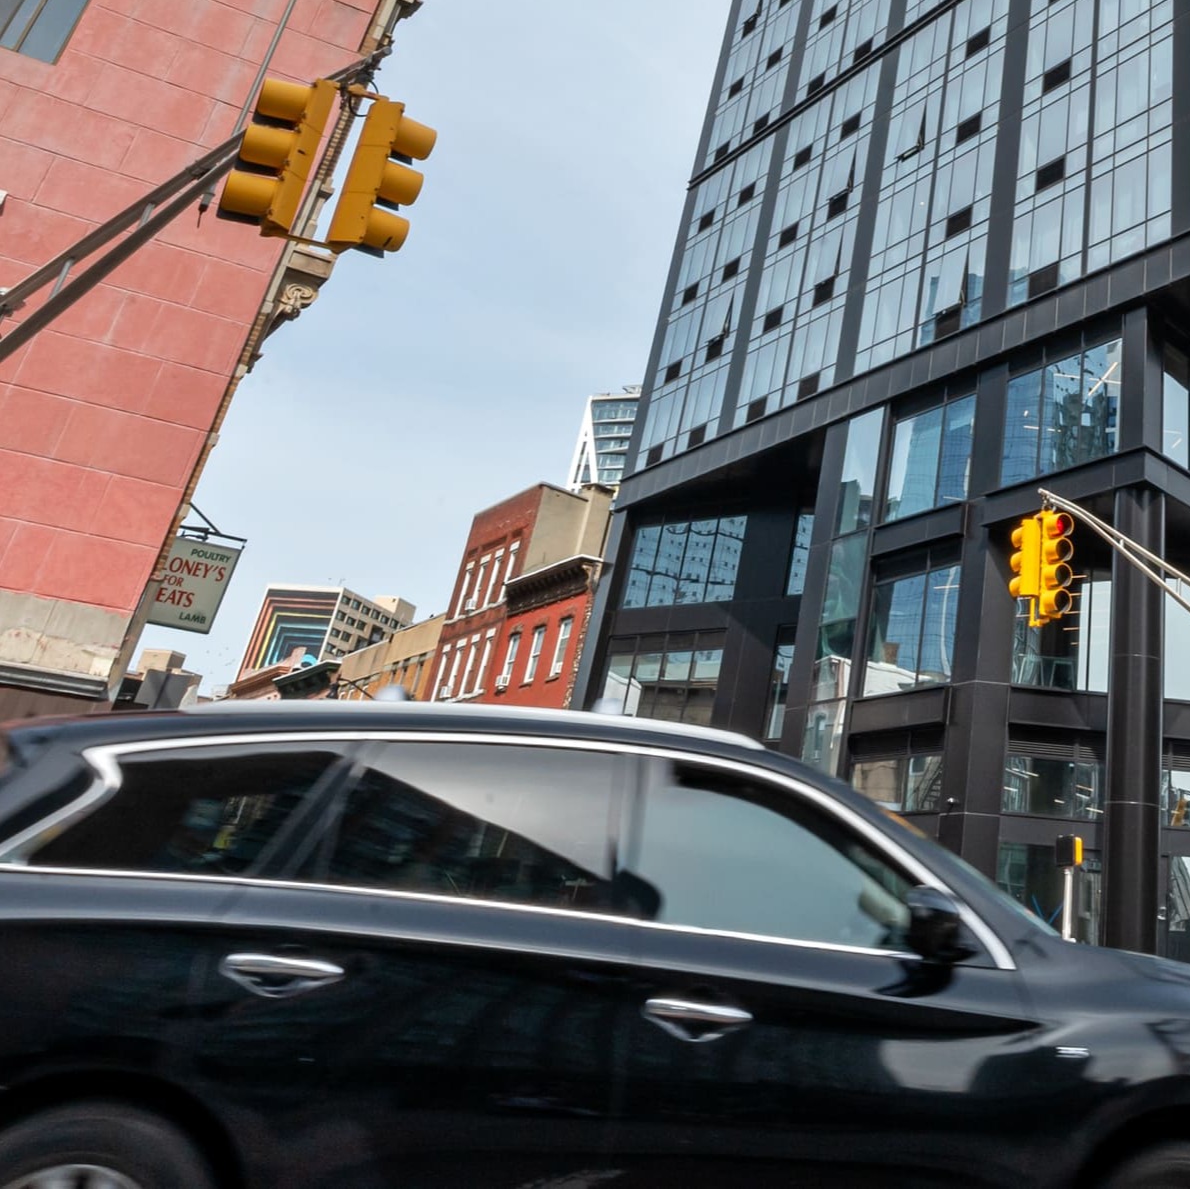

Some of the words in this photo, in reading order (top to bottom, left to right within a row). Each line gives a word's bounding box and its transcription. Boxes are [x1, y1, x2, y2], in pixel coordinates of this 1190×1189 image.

[190, 548, 231, 563] POULTRY
[162, 557, 226, 582] ONEY'S
[163, 574, 184, 587] FOR
[155, 587, 195, 608] EATS
[178, 612, 206, 624] LAMB
